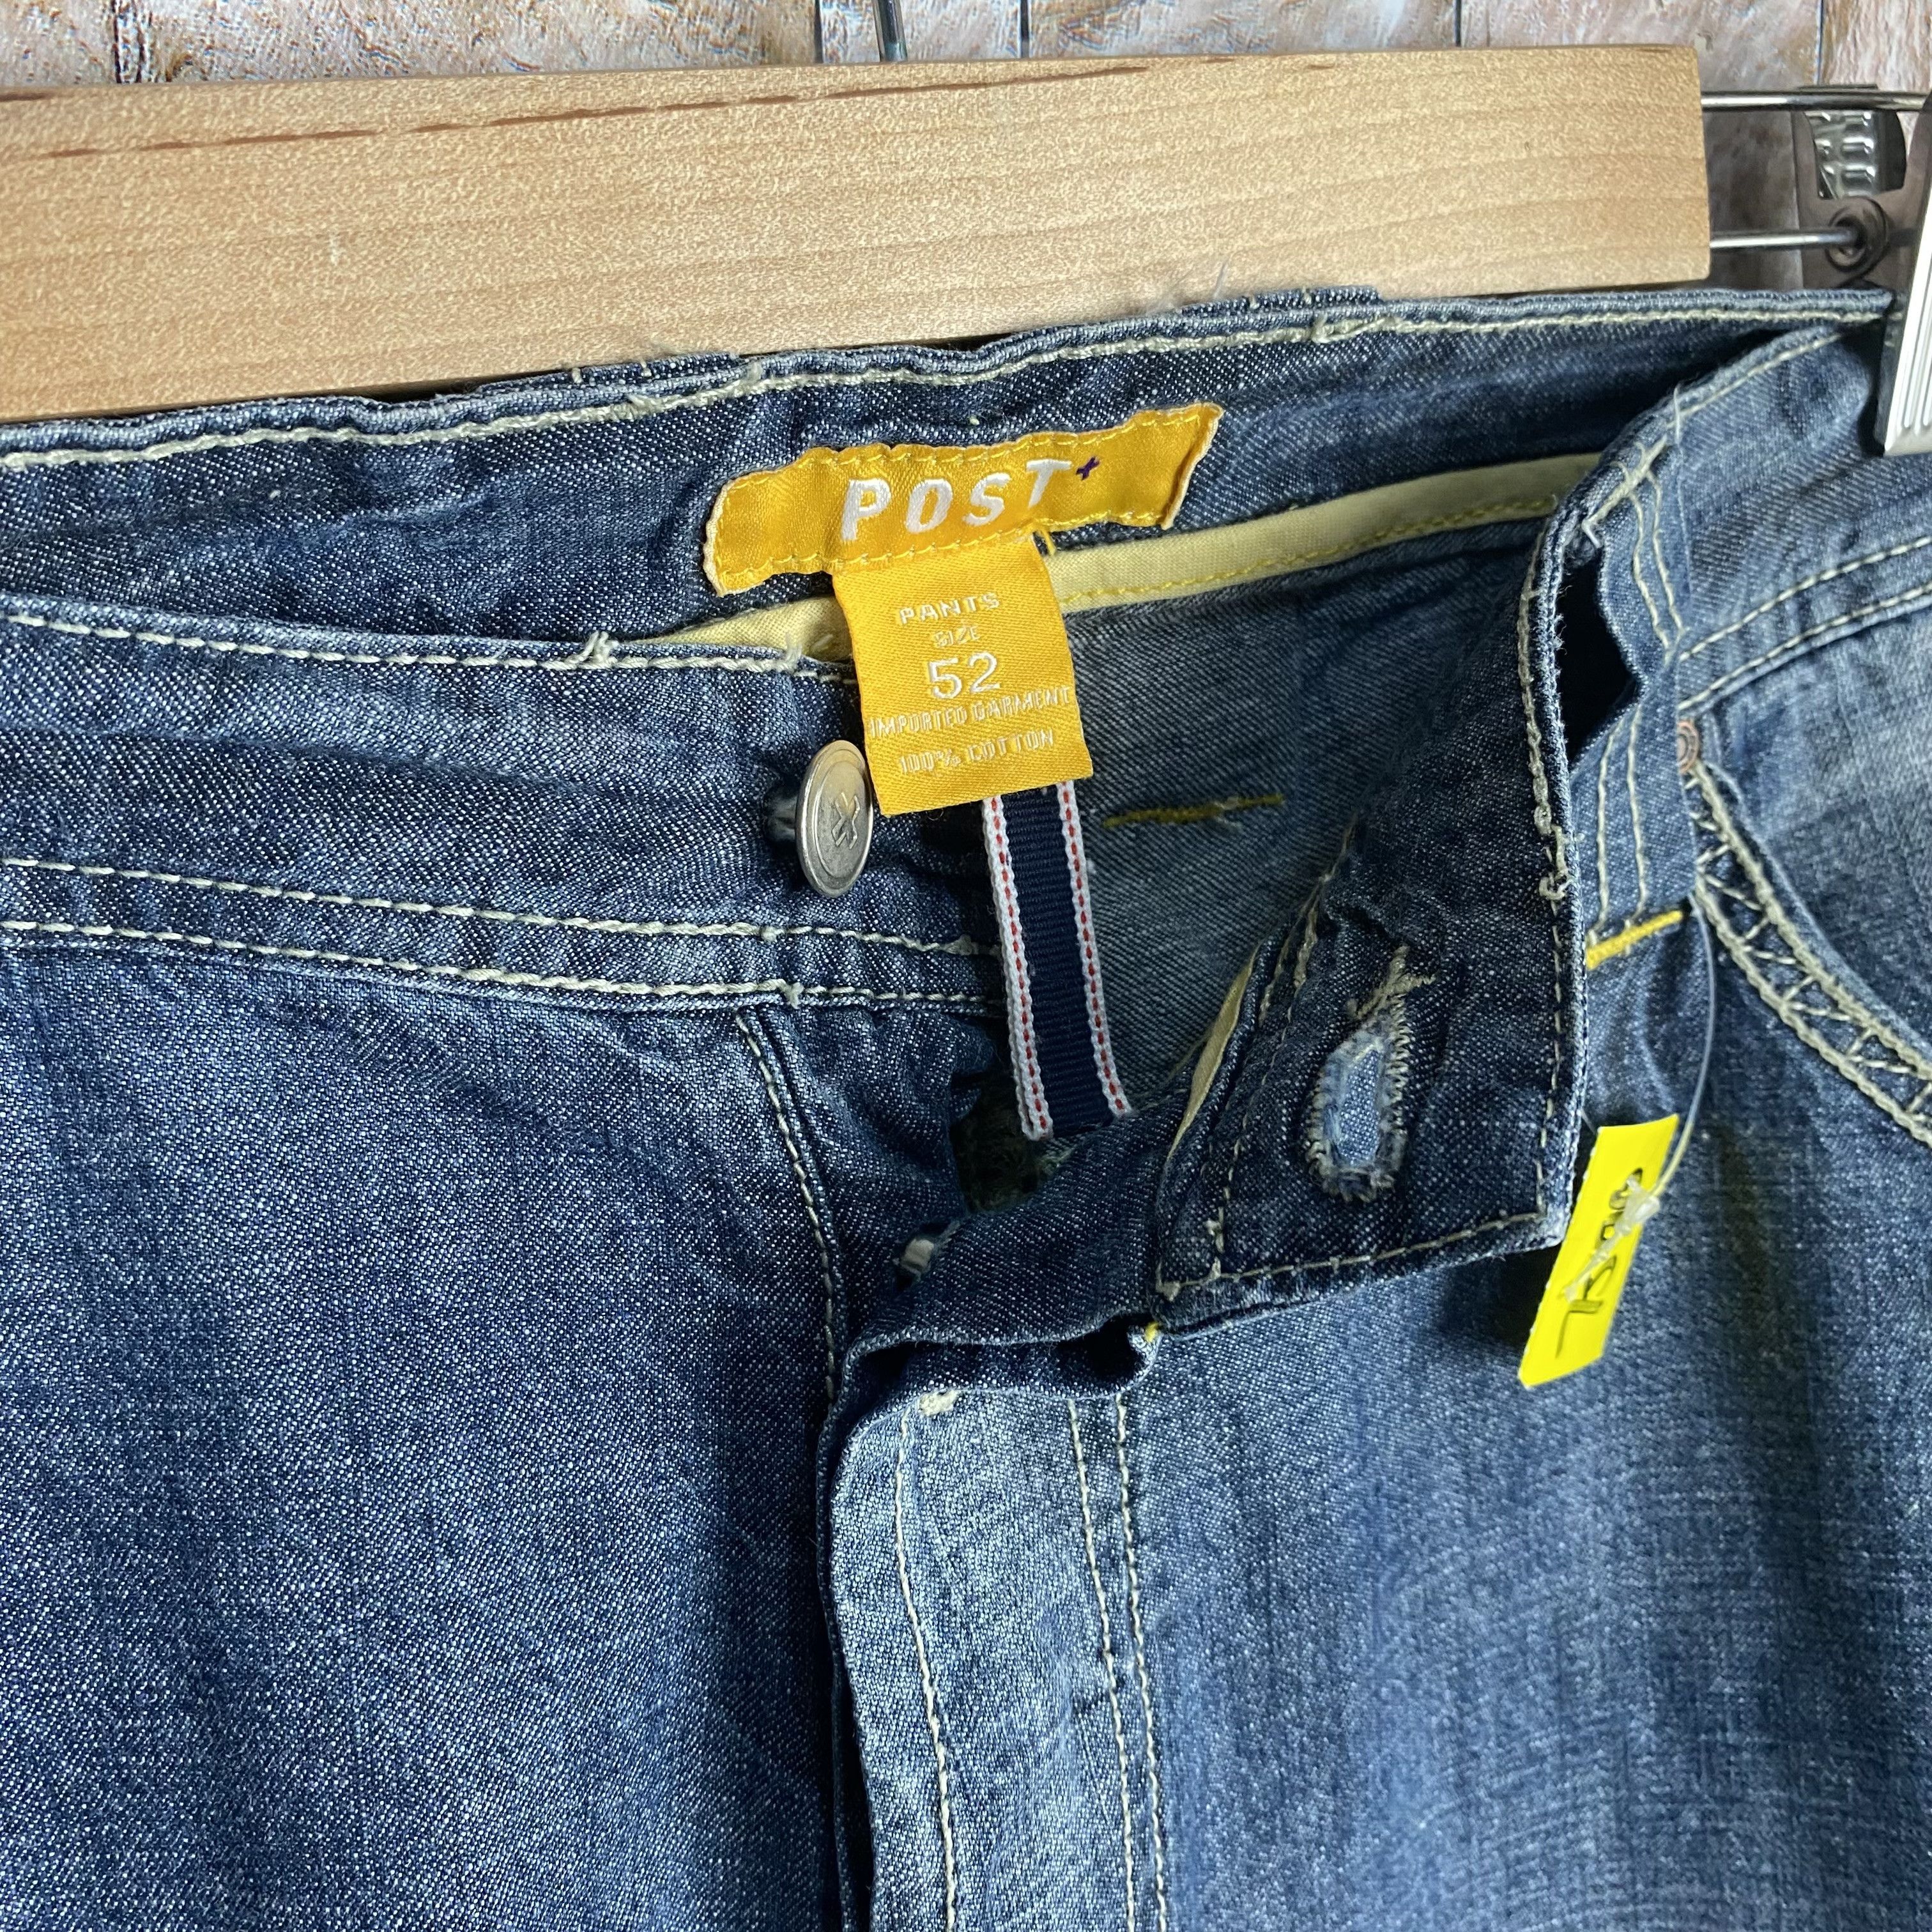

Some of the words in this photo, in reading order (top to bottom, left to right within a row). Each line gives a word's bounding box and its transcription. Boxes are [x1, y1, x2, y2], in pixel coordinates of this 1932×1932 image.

[899, 592, 1000, 625] PANTS
[933, 623, 982, 648] SIZE
[928, 650, 1001, 700] 52
[869, 705, 968, 737] IMPORTED
[972, 685, 1071, 722] GARMENT
[898, 747, 962, 775] 100%
[968, 728, 1054, 762] COTTON
